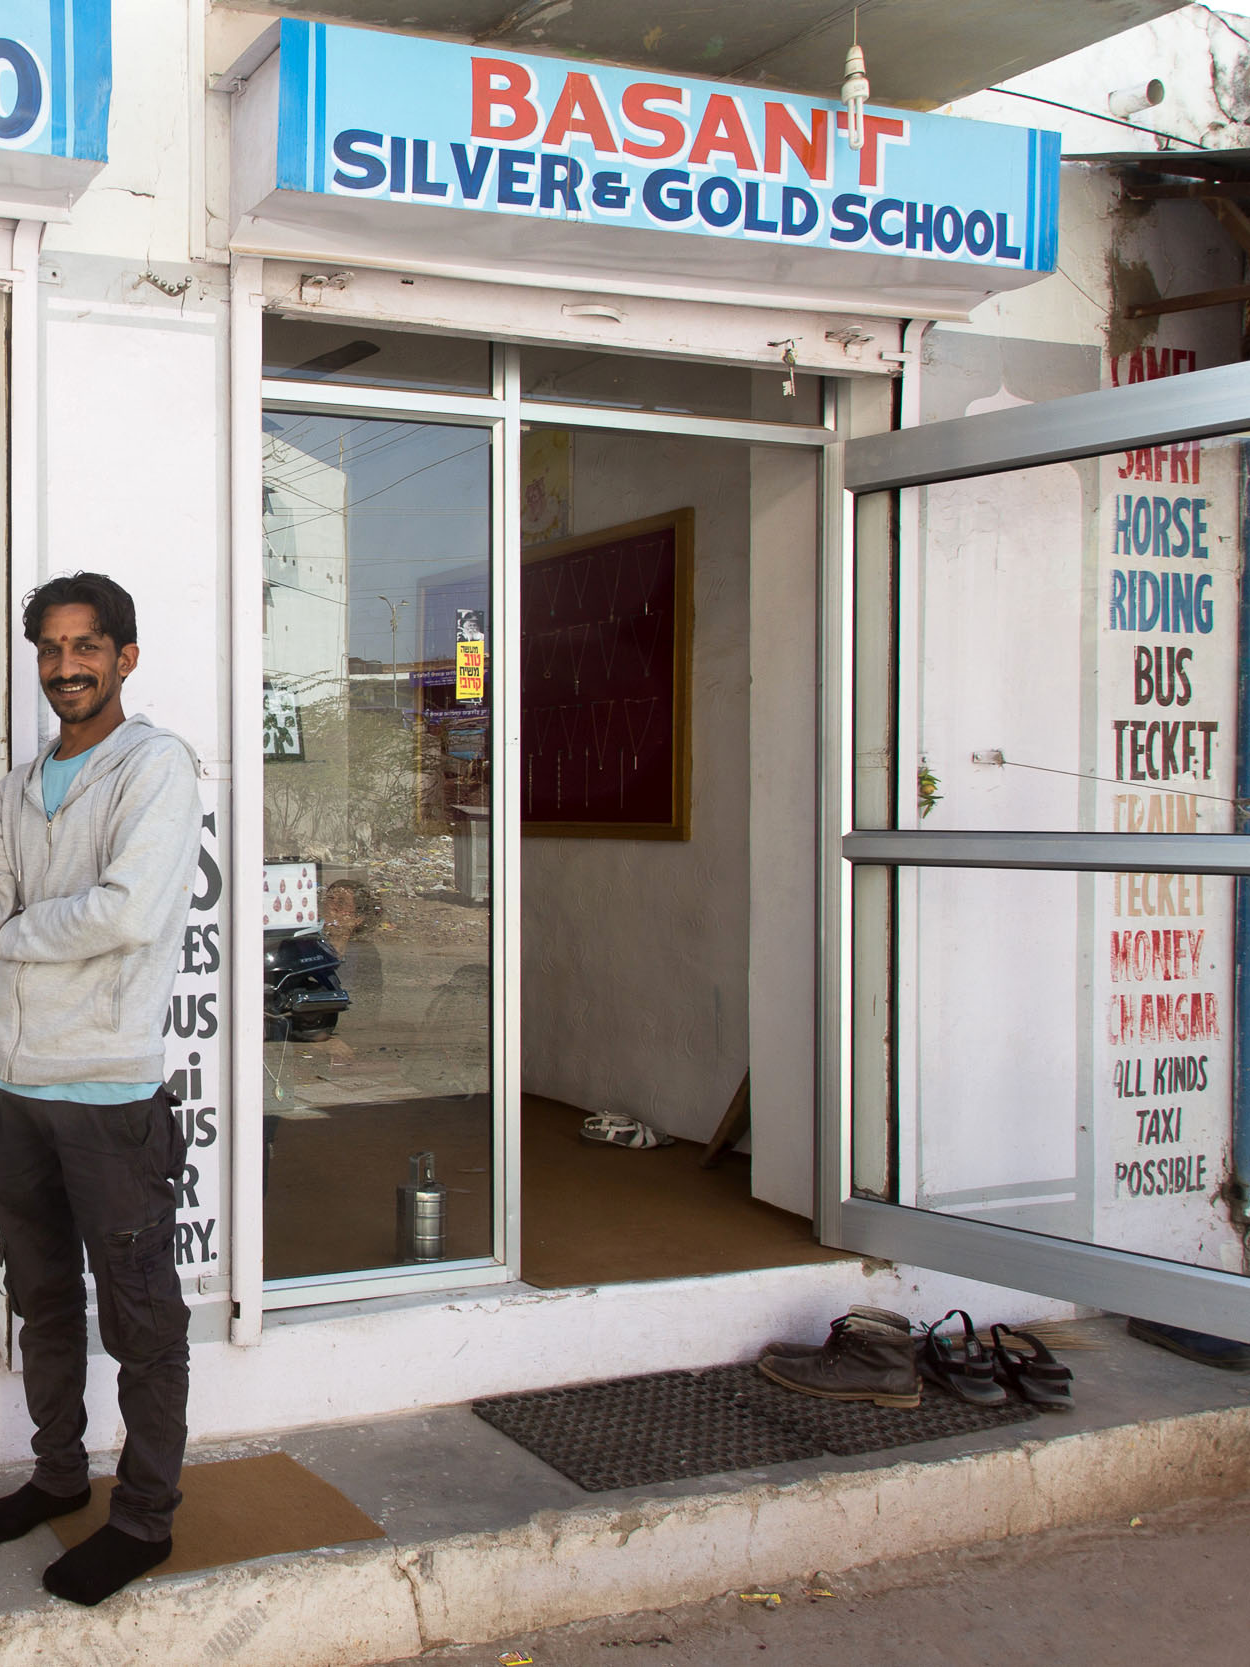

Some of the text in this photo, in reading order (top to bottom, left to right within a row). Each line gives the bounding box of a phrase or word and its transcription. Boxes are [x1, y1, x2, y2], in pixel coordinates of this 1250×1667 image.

[469, 57, 907, 190] BASANT
[331, 130, 1024, 264] SILVER & GOLD SCHOOL
[1114, 494, 1210, 559] HORSE
[1109, 570, 1213, 634] RIDING
[459, 666, 480, 677] משיח
[464, 653, 481, 666] טוב
[1134, 645, 1193, 707] BUS
[1111, 720, 1218, 782] TECKET
[178, 923, 220, 975] ES
[1110, 929, 1205, 983] MONEY
[1107, 992, 1222, 1046] CHANGAR
[1113, 1055, 1208, 1098] ALL KINDS
[1136, 1107, 1181, 1146] TAXI
[1113, 1154, 1207, 1199] POSSIBLE
